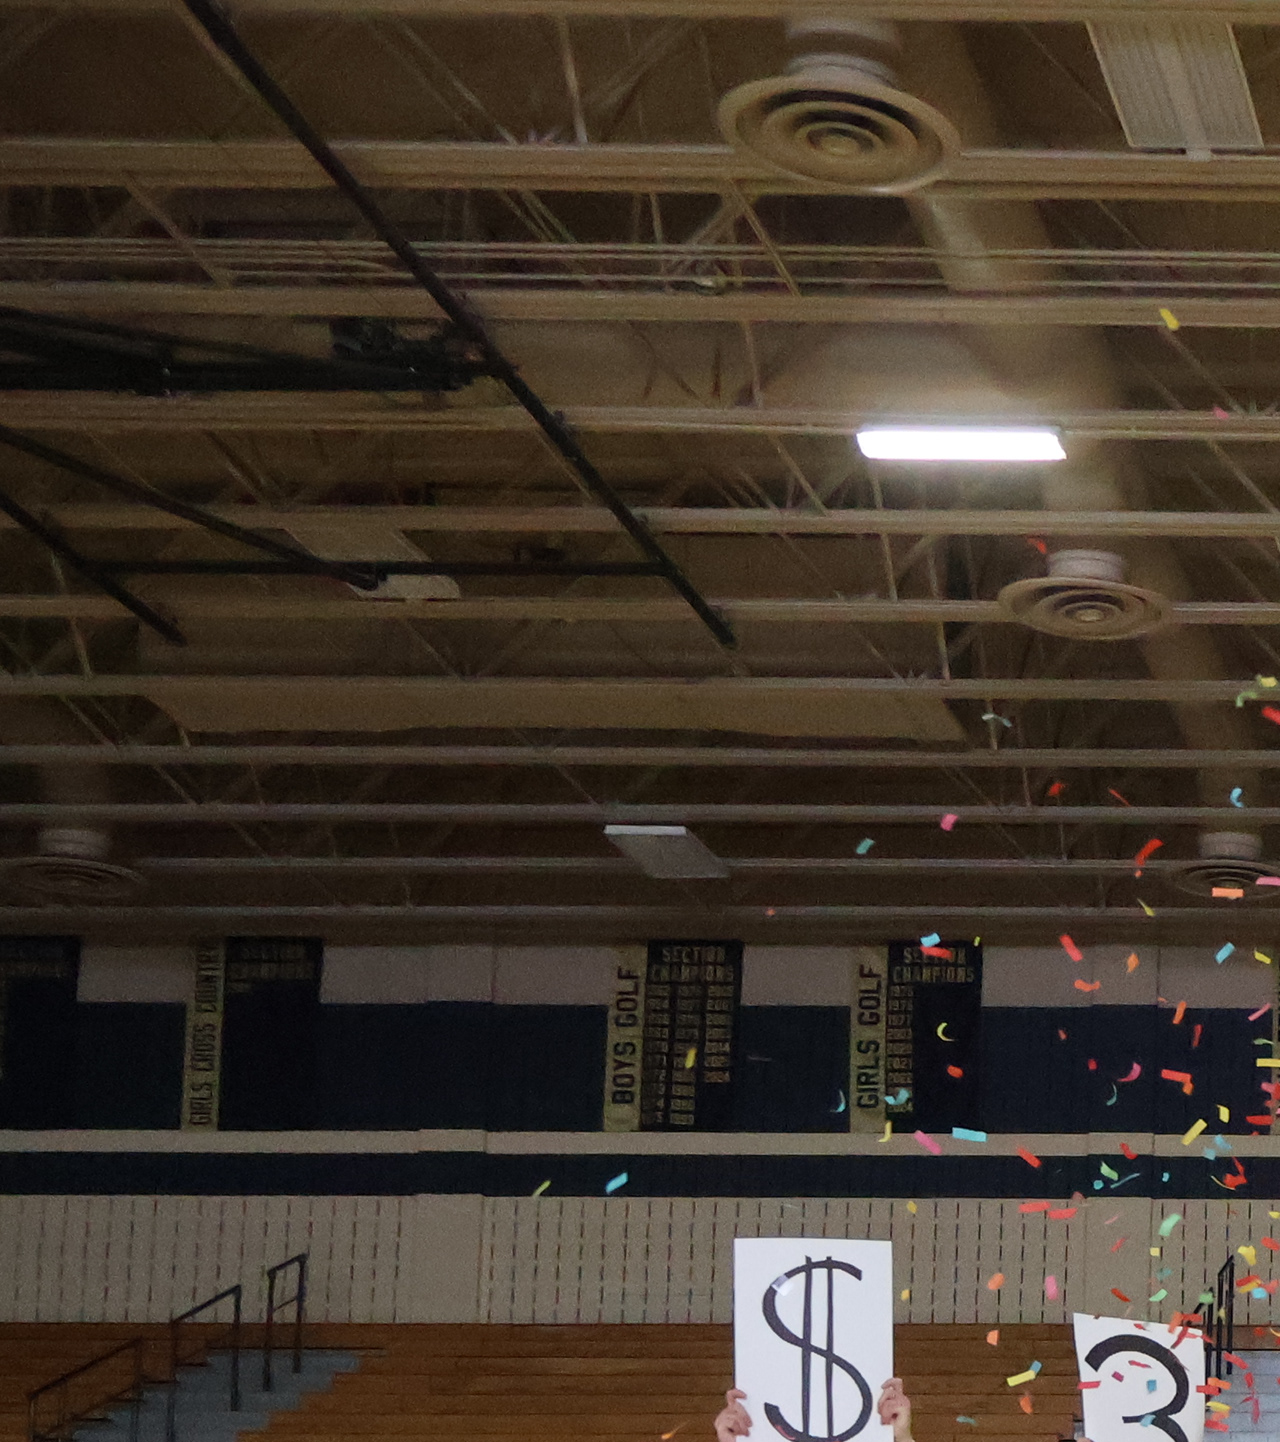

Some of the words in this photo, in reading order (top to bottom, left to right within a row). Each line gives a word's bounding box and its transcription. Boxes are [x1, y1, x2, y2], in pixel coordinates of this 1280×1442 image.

[615, 966, 640, 1027] GOLF
[858, 964, 881, 1027] GOLF
[893, 967, 975, 983] CHAMPIONS
[612, 1042, 636, 1104] BOYS
[857, 1040, 880, 1109] GIRLS
[188, 1082, 213, 1126] GIRLS
